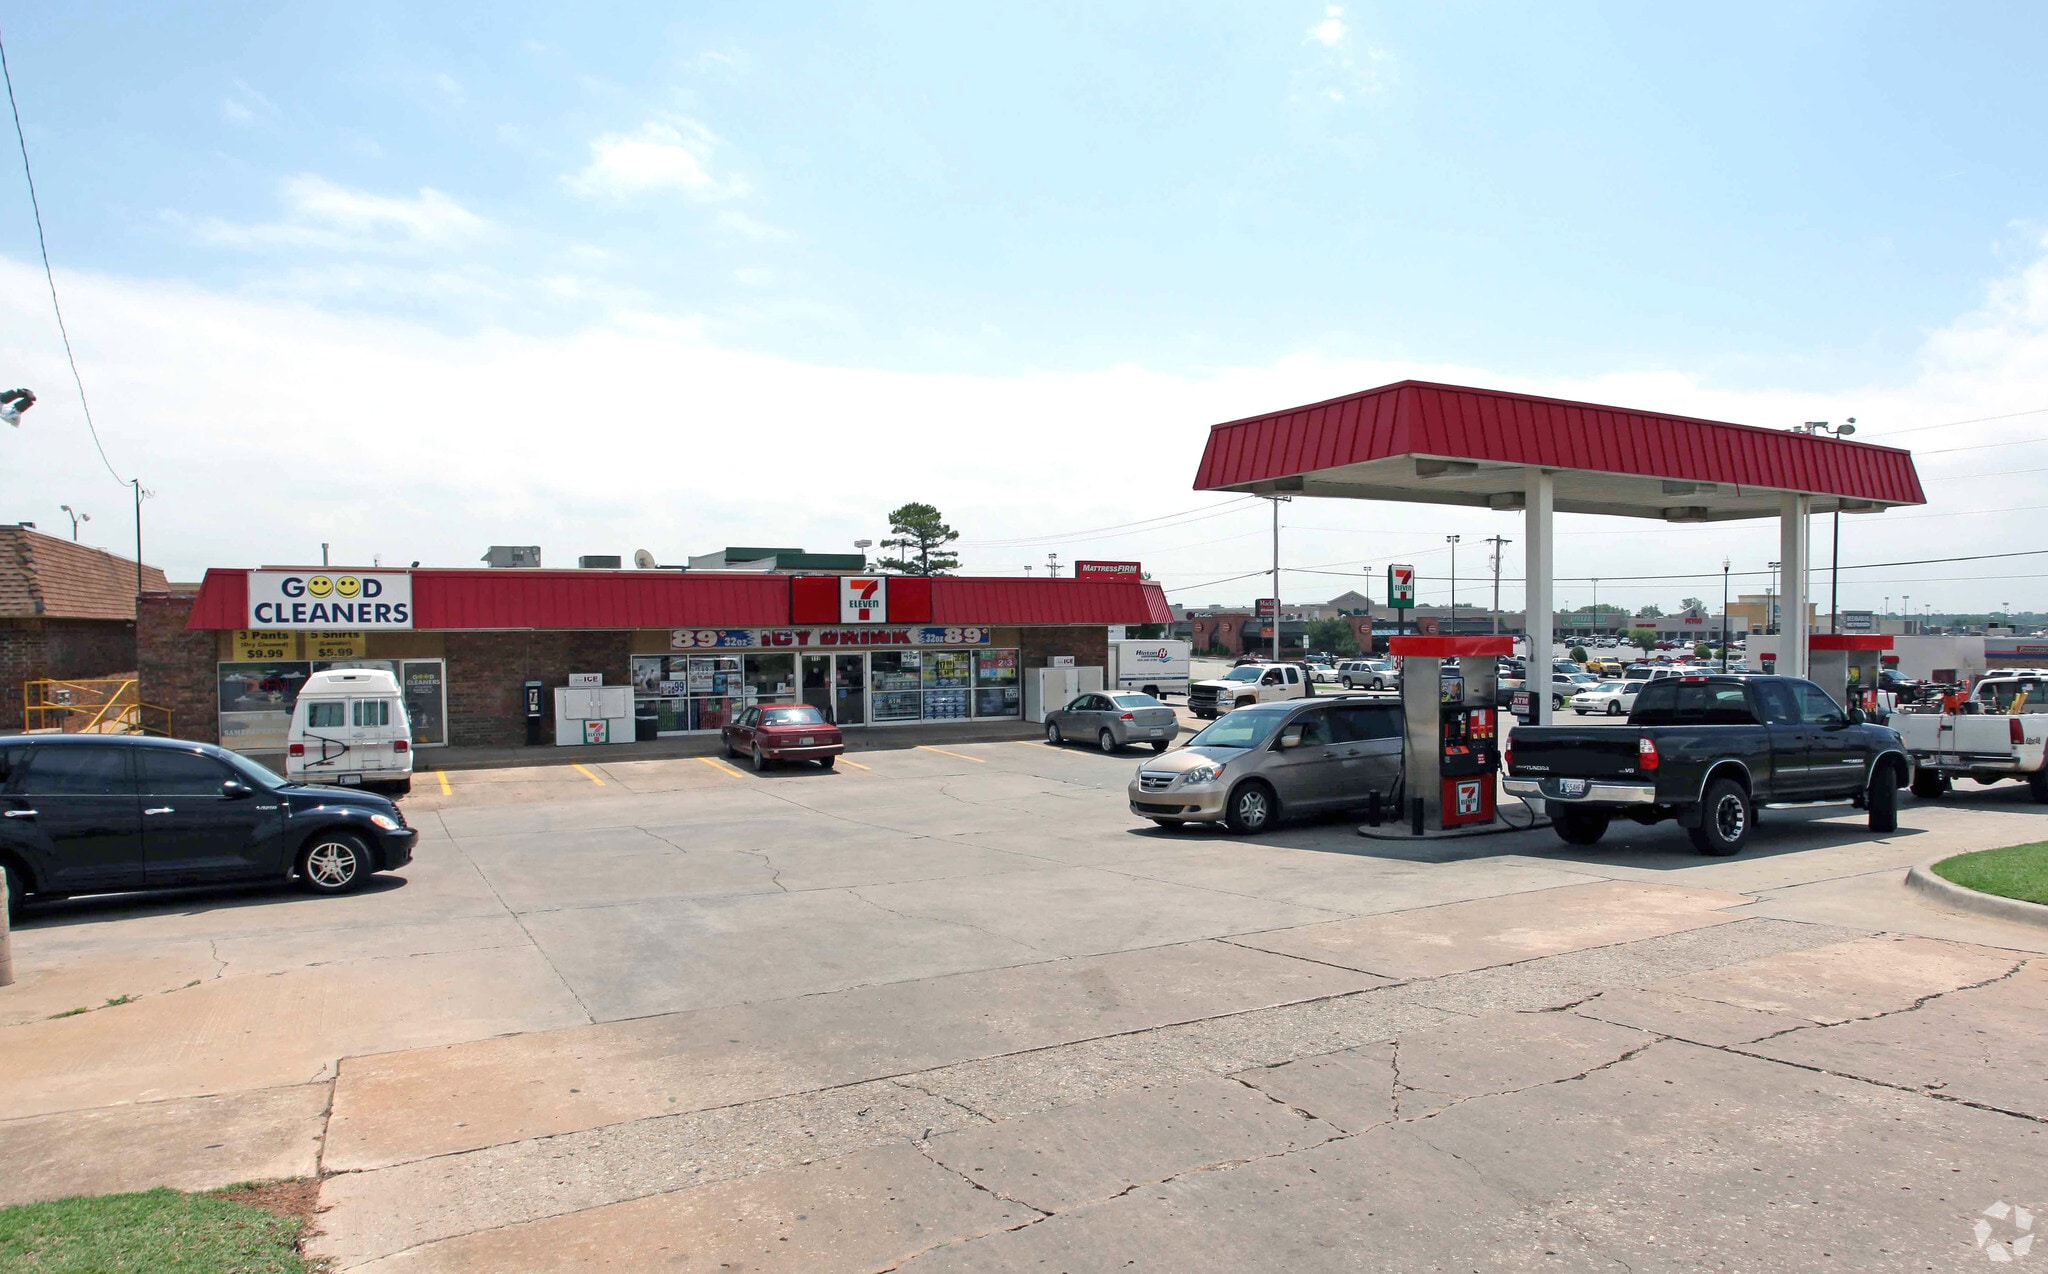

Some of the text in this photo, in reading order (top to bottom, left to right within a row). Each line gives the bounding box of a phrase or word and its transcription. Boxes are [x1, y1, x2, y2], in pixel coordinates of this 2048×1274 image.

[254, 602, 409, 624] CLEANERS
[239, 631, 289, 640] 3 Pants
[322, 631, 360, 639] Shirts
[723, 636, 749, 647] 32oz
[760, 629, 814, 647] ICY
[819, 628, 912, 646] DRINK
[925, 633, 944, 643] 32oz
[247, 649, 284, 659] $9.99
[318, 648, 354, 658] $5.99
[583, 675, 599, 683] ICE
[1512, 697, 1529, 705] ATM
